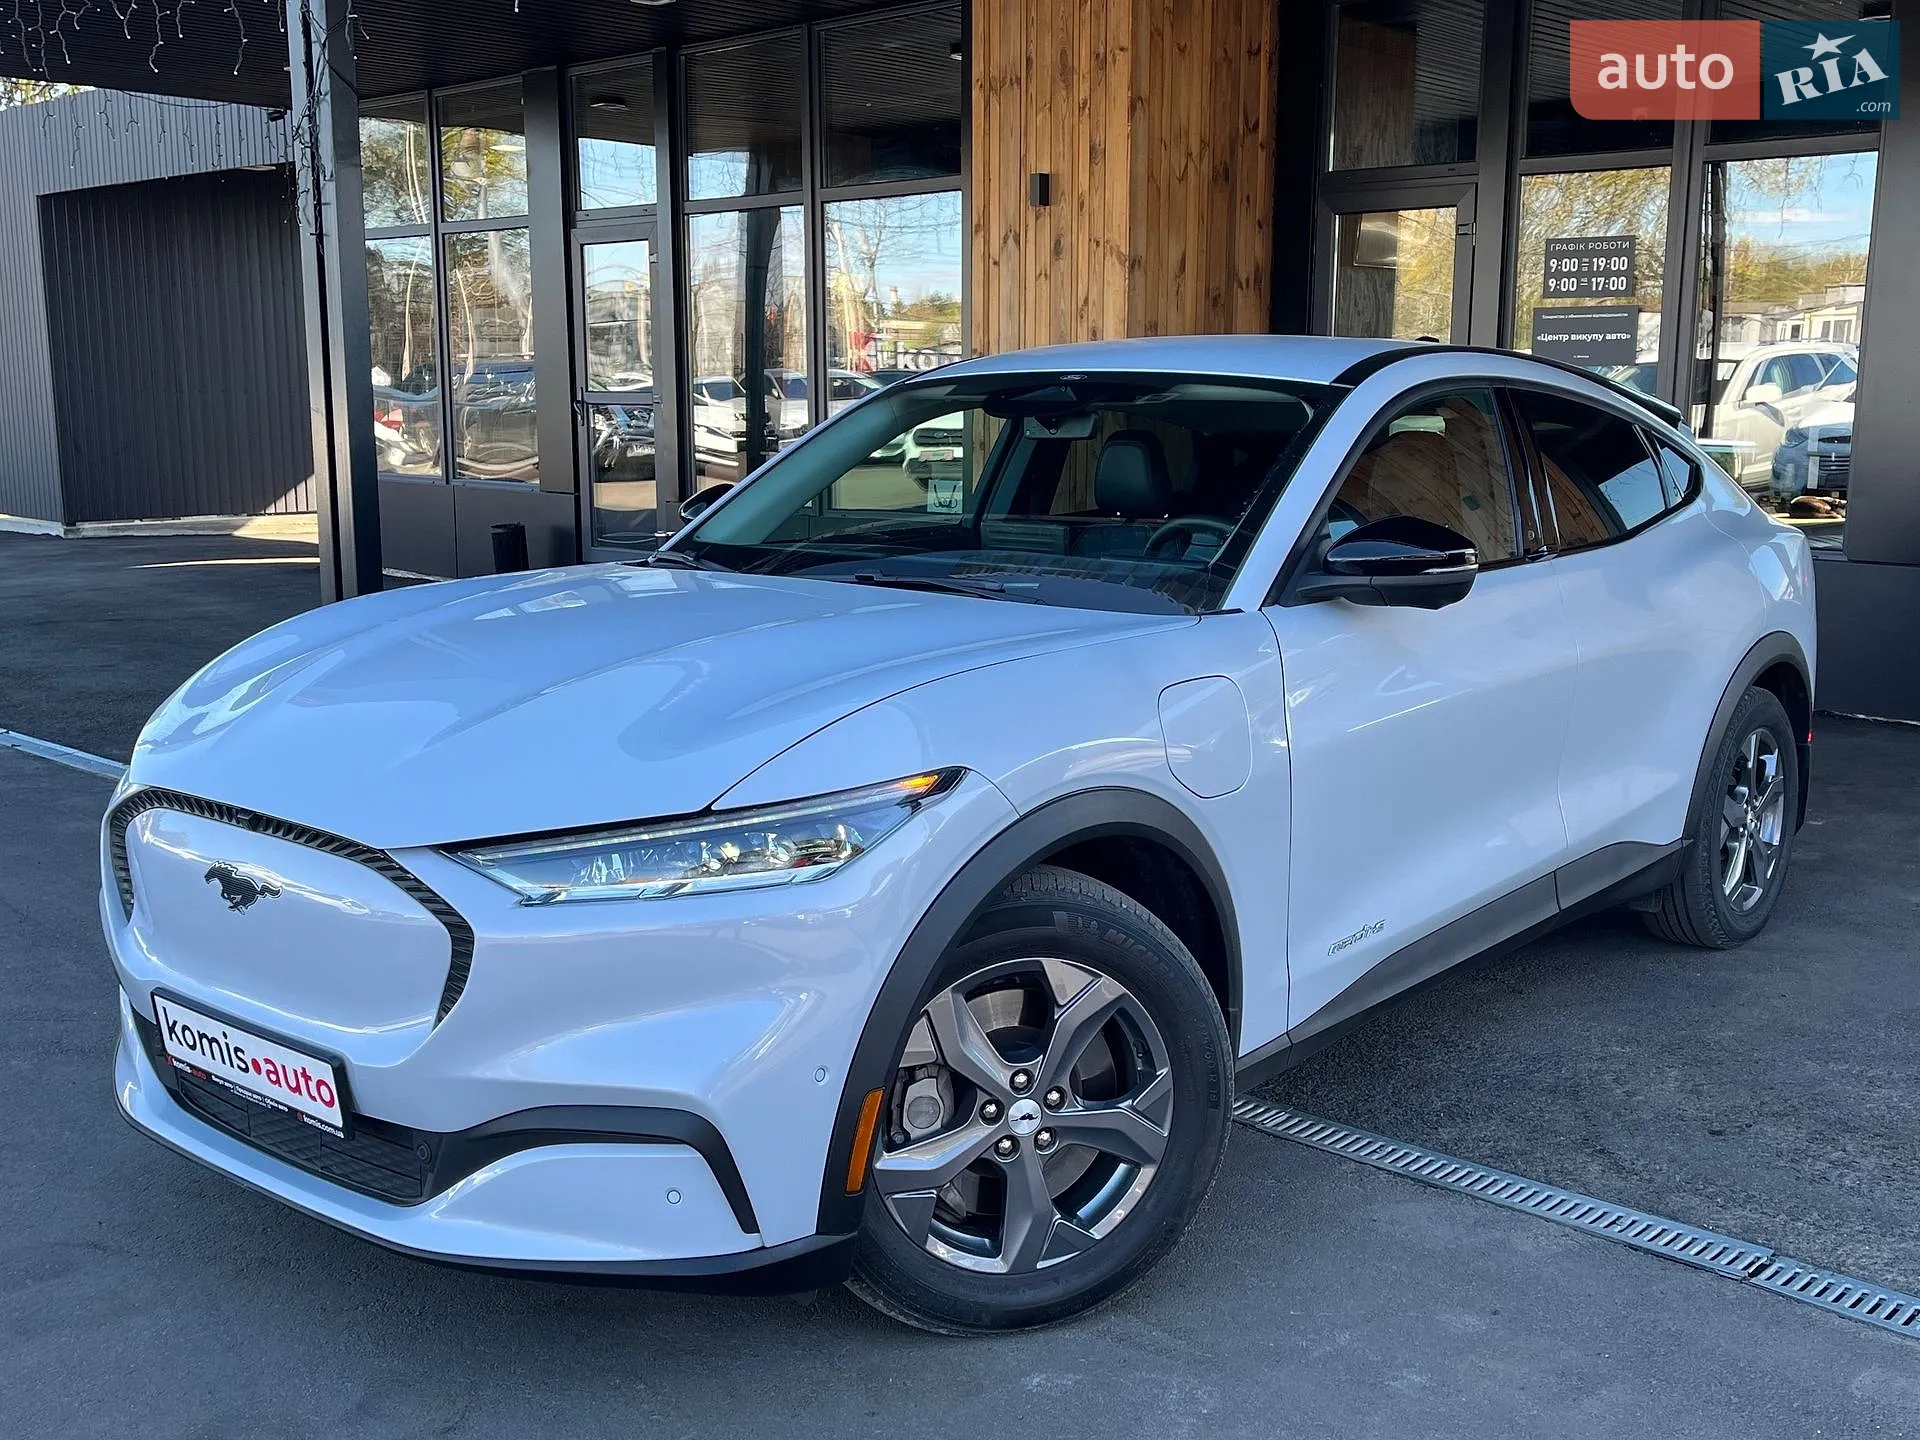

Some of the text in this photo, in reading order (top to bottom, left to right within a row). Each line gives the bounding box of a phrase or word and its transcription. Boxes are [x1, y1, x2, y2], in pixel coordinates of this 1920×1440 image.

[1550, 241, 1630, 251] ГРАФІК РОБОТИ
[1549, 256, 1628, 273] 9:00 19:00
[1548, 276, 1627, 292] 9:00 17:00
[1571, 333, 1604, 342] викупу
